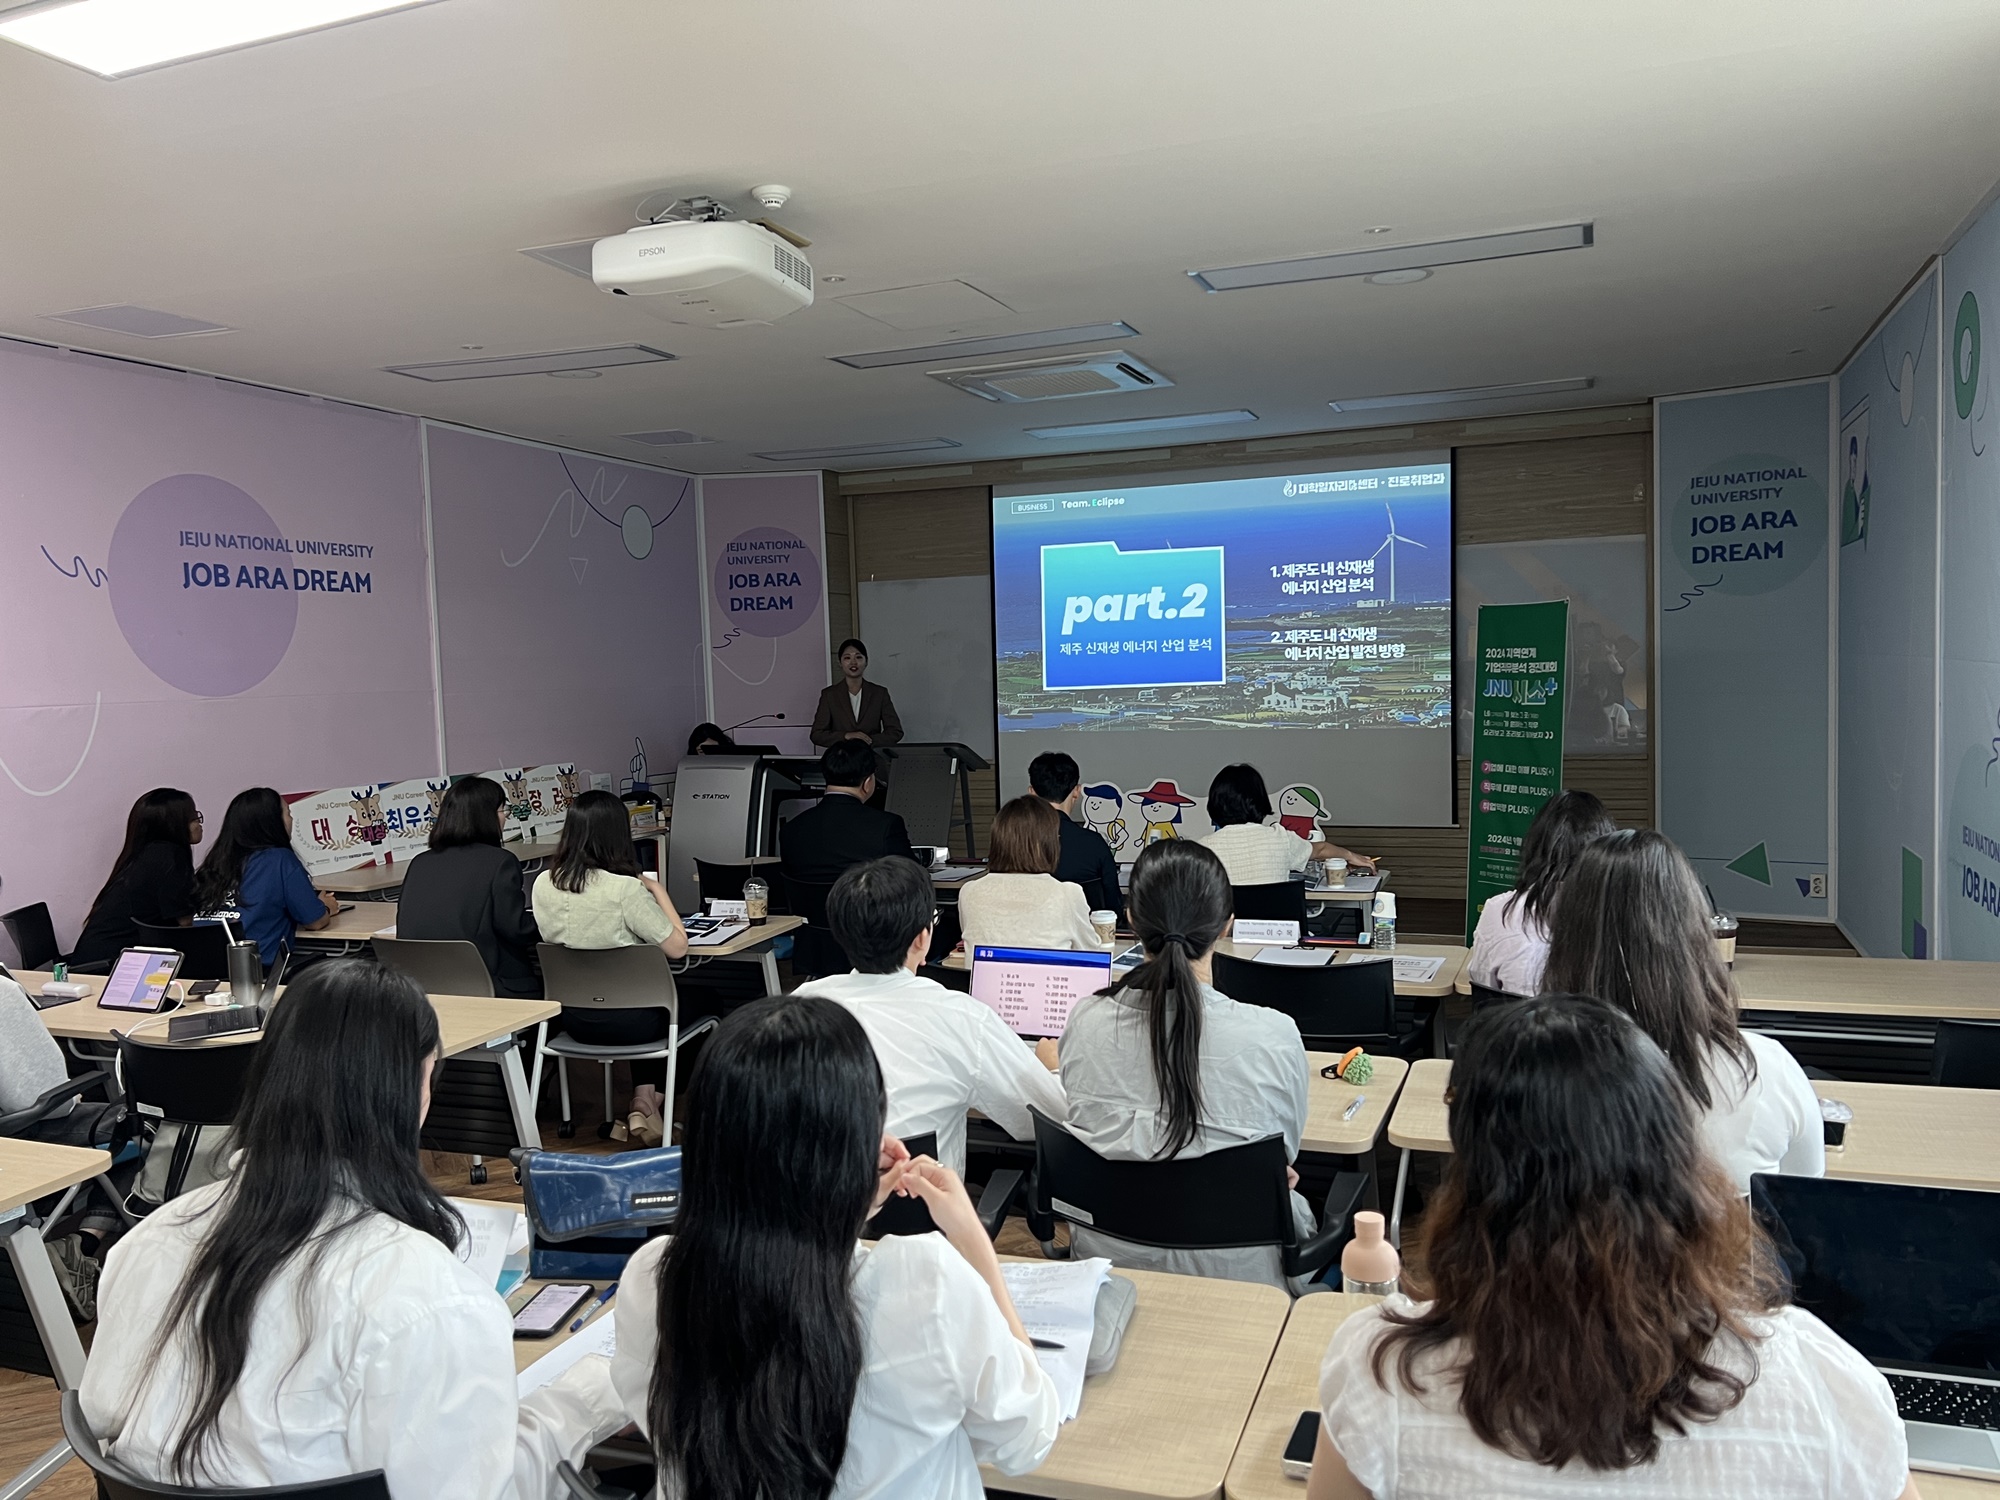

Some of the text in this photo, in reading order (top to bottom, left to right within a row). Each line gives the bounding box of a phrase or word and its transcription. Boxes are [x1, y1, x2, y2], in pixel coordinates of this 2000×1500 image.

[638, 246, 666, 257] EPSON
[1387, 472, 1446, 488] 진로취업과
[1690, 467, 1807, 490] JEJU NATIONAL
[1061, 497, 1125, 509] Team. Eclipse
[1690, 487, 1783, 506] UNIVERSITY
[1017, 503, 1048, 512] BUSINESS
[1690, 509, 1798, 537] JOB ARA
[179, 531, 374, 558] JEJU NATIONAL UNIVERSITY
[726, 540, 806, 552] JEJU NATIONAL
[1692, 540, 1783, 564] DREAM
[727, 554, 791, 566] UNIVERSITY
[1270, 559, 1375, 578] 1. 제주도 내 신재생
[183, 562, 372, 593] JOB ARA DREAM
[729, 572, 802, 590] JOB ARA
[1281, 576, 1375, 595] 에너지 산업 분석
[730, 596, 793, 612] DREAM
[1061, 582, 1209, 636] part.2
[1270, 626, 1378, 644] 2. 제주도 내 신재생
[1059, 637, 1212, 656] 제주 신재생 에너지 산업 분석
[1284, 643, 1406, 661] 에너지 산업 발전 방향
[330, 801, 349, 809] Caree
[311, 818, 331, 841] 대
[1962, 865, 1980, 903] JOB
[635, 1196, 675, 1204] FREITAG
